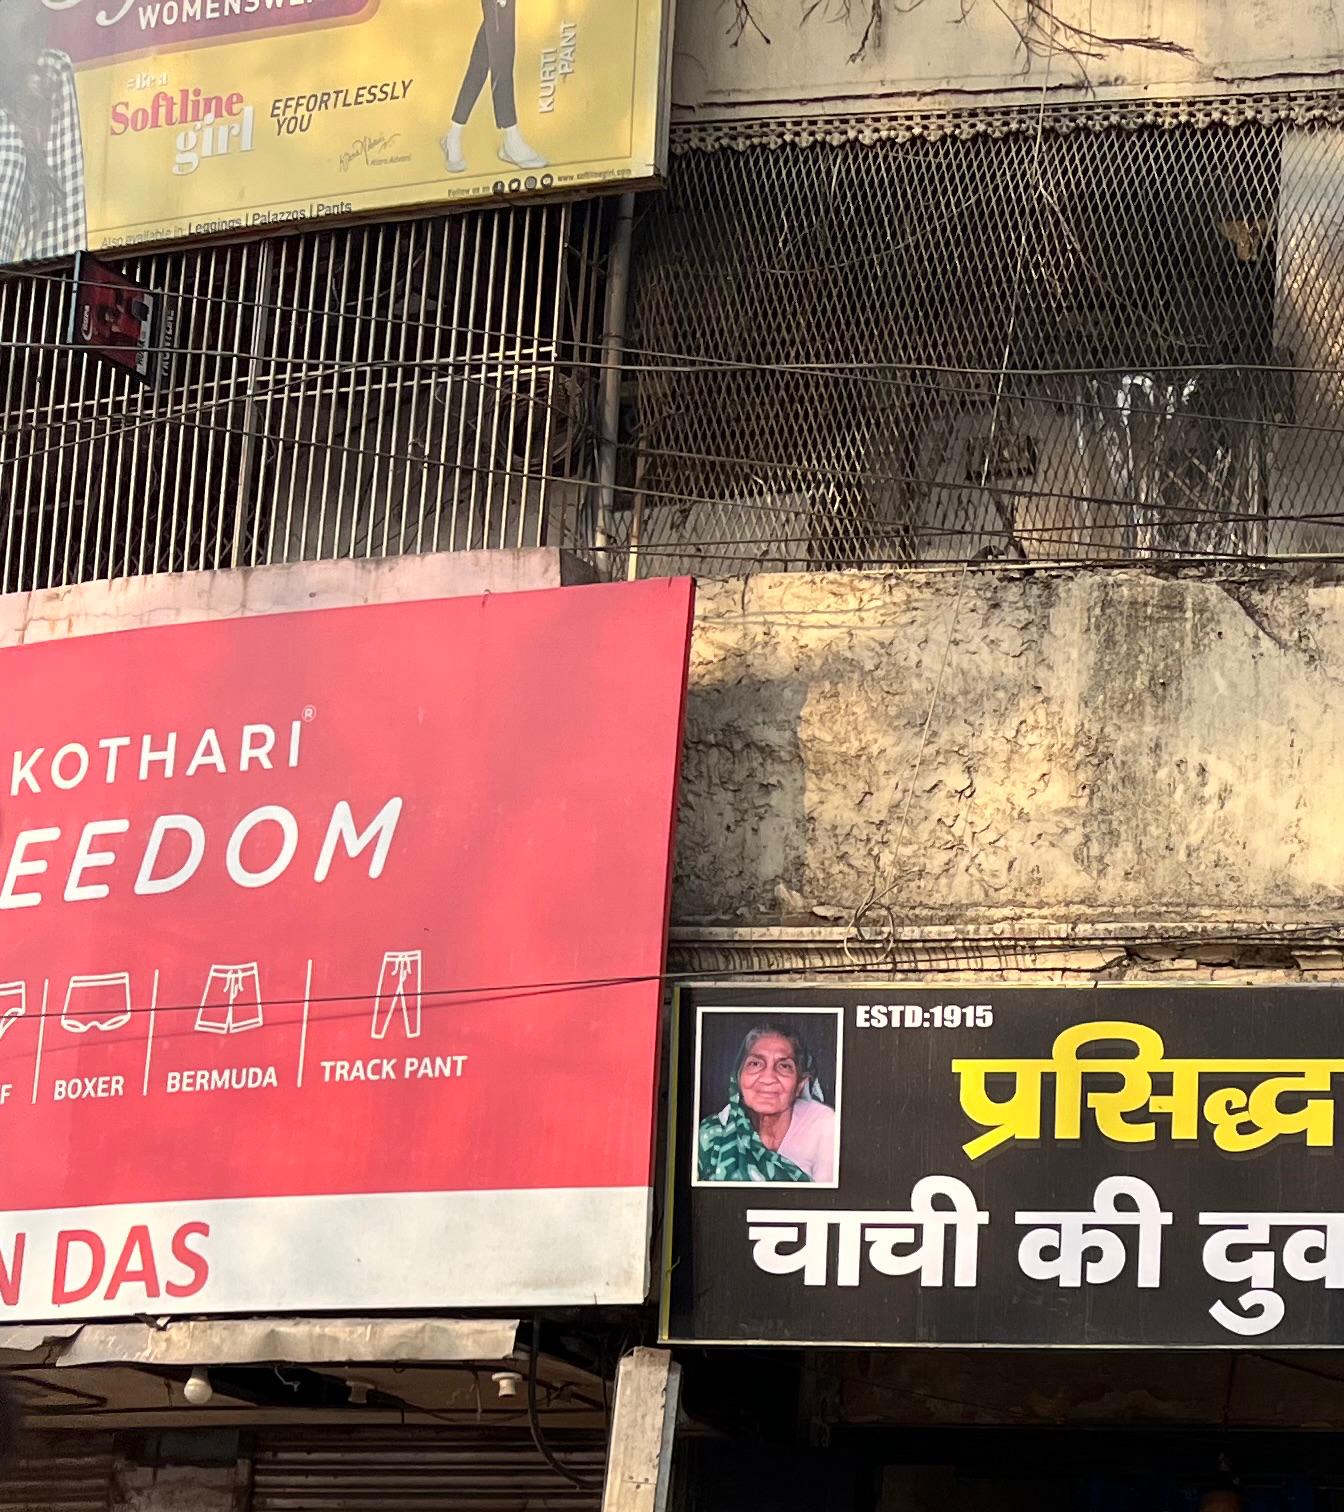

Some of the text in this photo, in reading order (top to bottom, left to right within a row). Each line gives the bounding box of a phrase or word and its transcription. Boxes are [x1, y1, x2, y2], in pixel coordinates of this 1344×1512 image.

[560, 19, 577, 75] PANT
[270, 79, 414, 118] EFFORTLESSLY
[539, 48, 558, 114] KURTI
[110, 88, 244, 136] Softline
[276, 114, 312, 136] YOU
[172, 103, 256, 176] girl
[252, 208, 306, 226] Palazzos
[316, 201, 352, 217] Pants
[10, 720, 302, 797] KOTHARI
[0, 796, 403, 910] EEDOM
[856, 1005, 994, 1029] ESTD:1915
[53, 1075, 125, 1101] BOXER
[166, 1065, 278, 1094] BERMUDA
[320, 1055, 469, 1083] TRACK PANT
[747, 1175, 988, 1287] चाची
[1015, 1175, 1172, 1289] की
[51, 1221, 210, 1305] DAS
